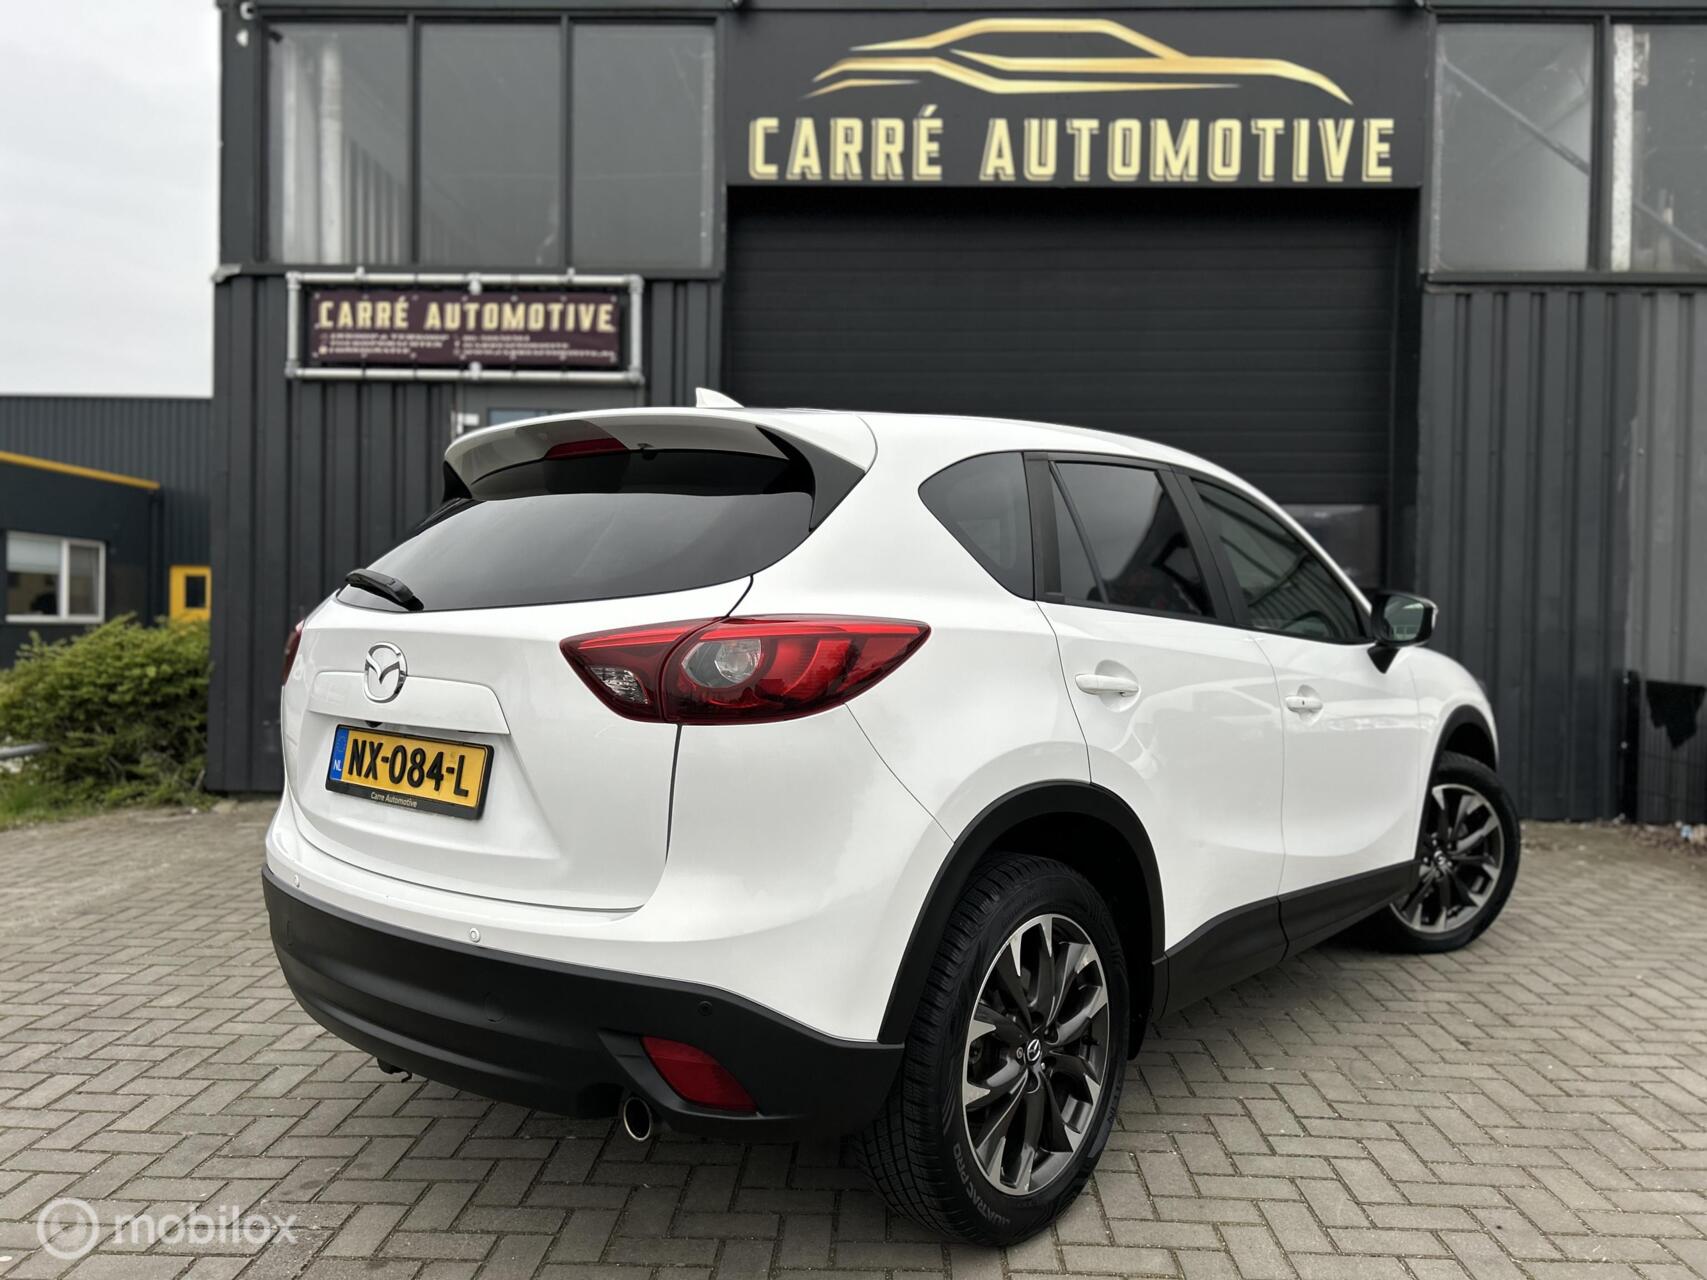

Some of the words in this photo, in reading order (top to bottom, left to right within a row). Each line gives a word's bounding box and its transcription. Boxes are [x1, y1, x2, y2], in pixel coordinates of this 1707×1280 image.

[749, 105, 944, 182] CARRÉ
[979, 117, 1394, 183] AUTOMOTIVE
[319, 296, 409, 329] CARRÉ
[423, 302, 617, 332] AUTOMOTIVE
[332, 759, 342, 772] NL
[347, 738, 469, 798] NX-084-L
[385, 794, 417, 807] Automotive
